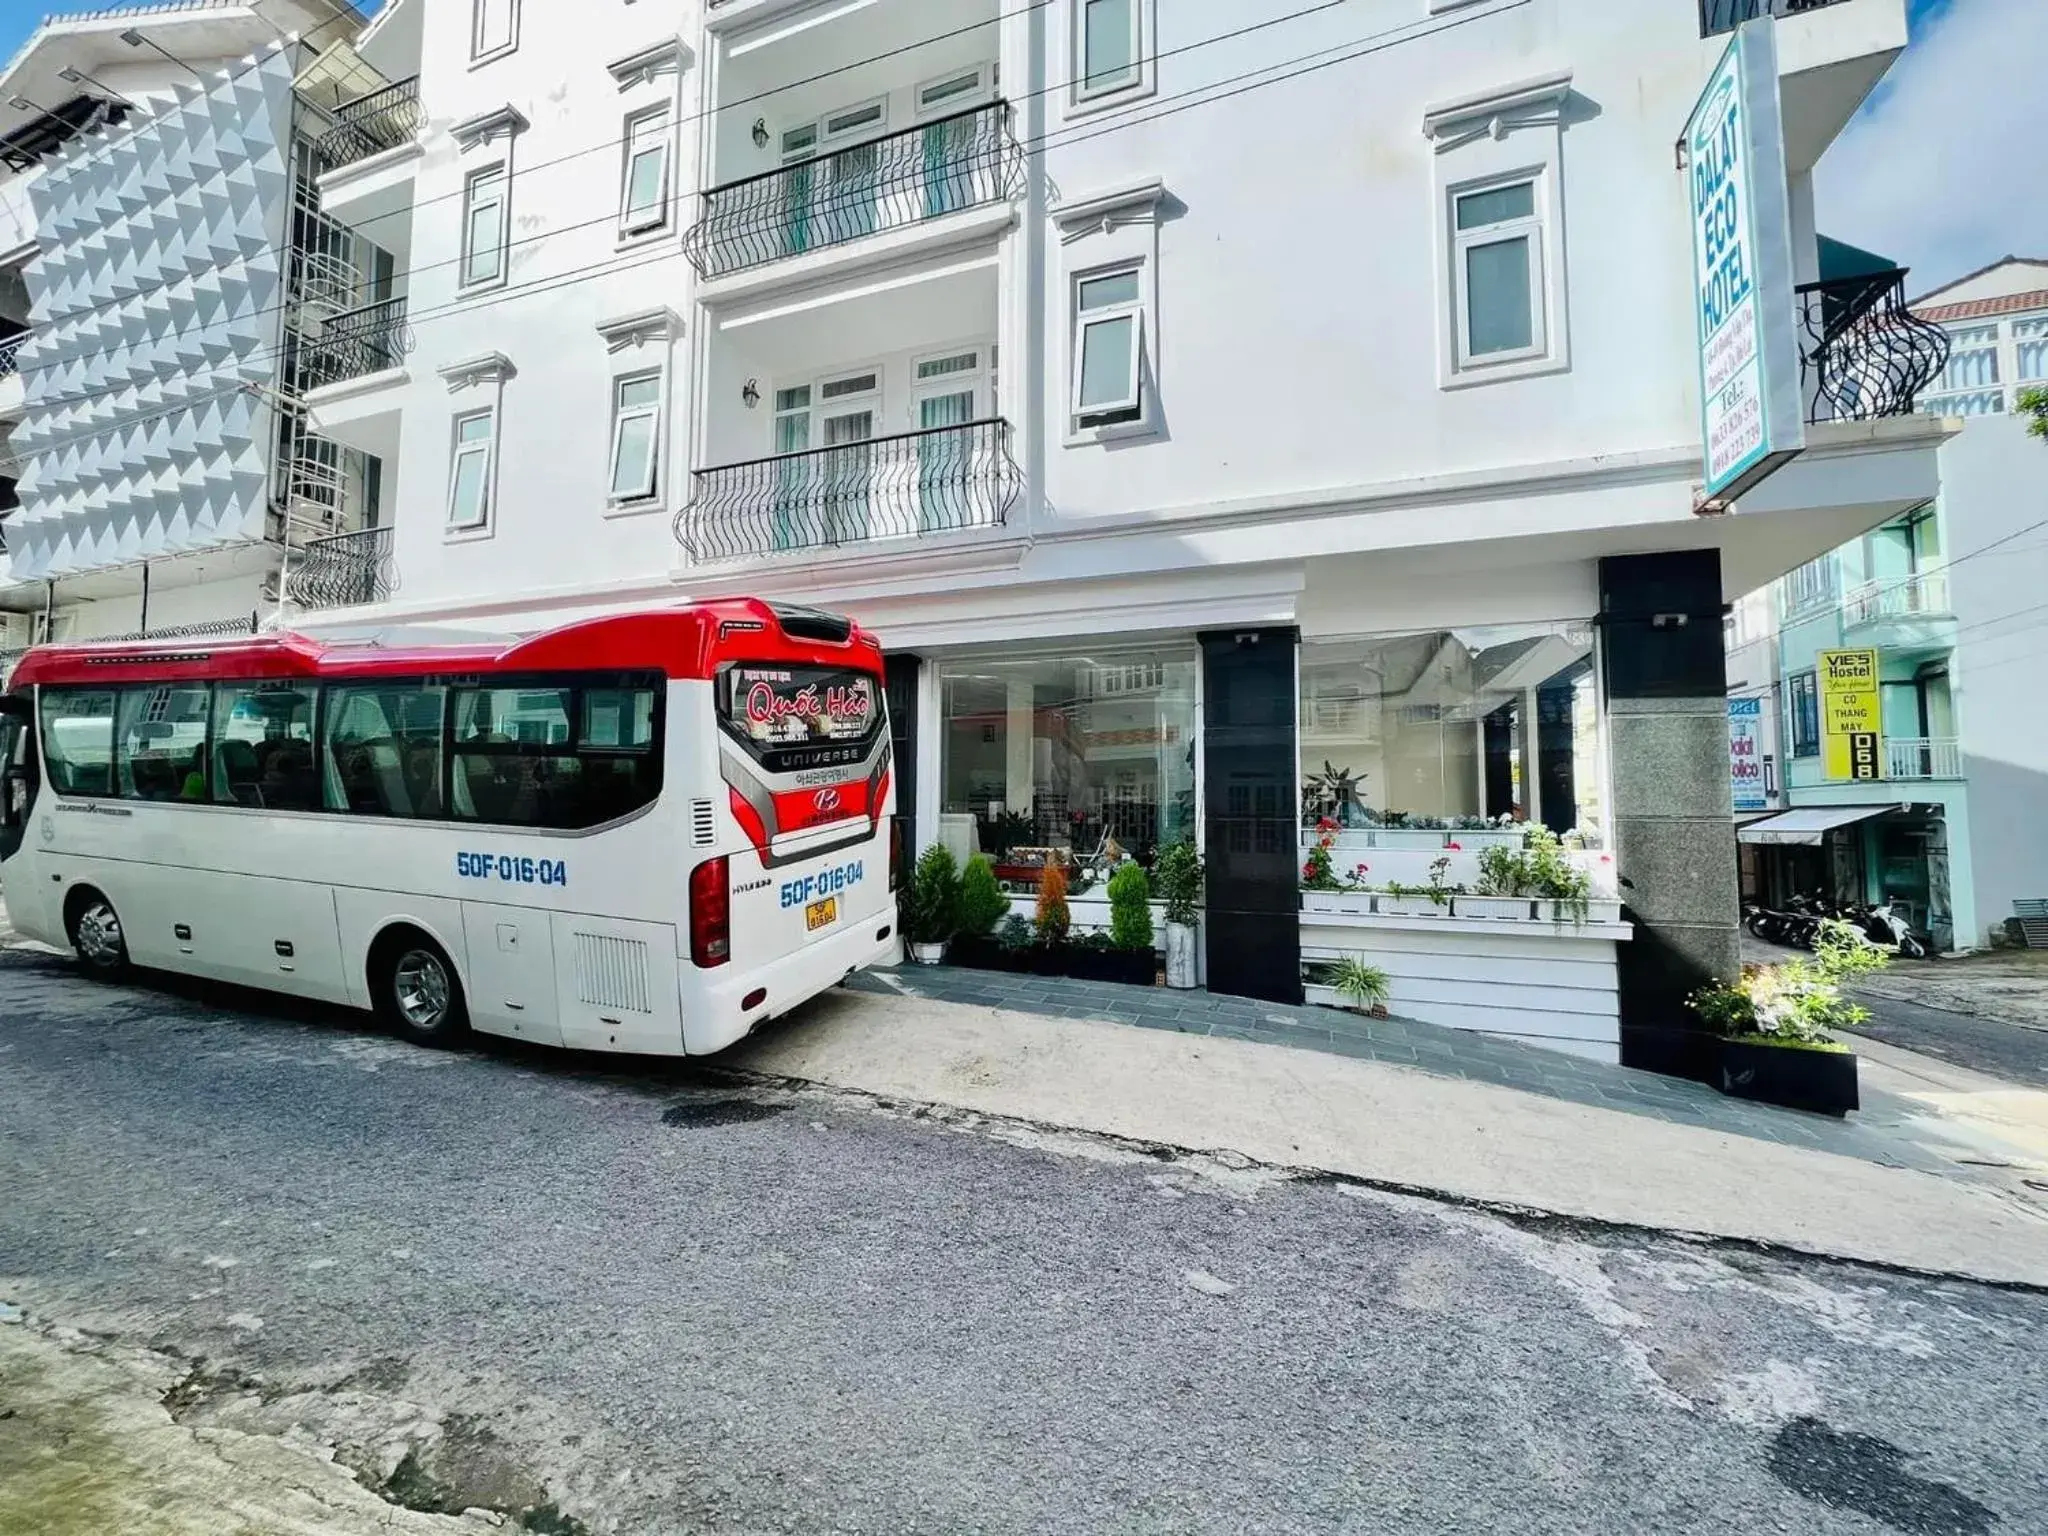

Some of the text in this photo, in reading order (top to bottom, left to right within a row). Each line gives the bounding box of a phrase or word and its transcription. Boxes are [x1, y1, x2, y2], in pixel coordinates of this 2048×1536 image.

[1696, 102, 1737, 217] DALAT
[1704, 181, 1736, 269] ECO
[1702, 240, 1749, 338] HOTEL
[747, 683, 822, 723] Quốc
[1829, 665, 1870, 678] Hostel
[781, 748, 859, 766] UNIVERSE
